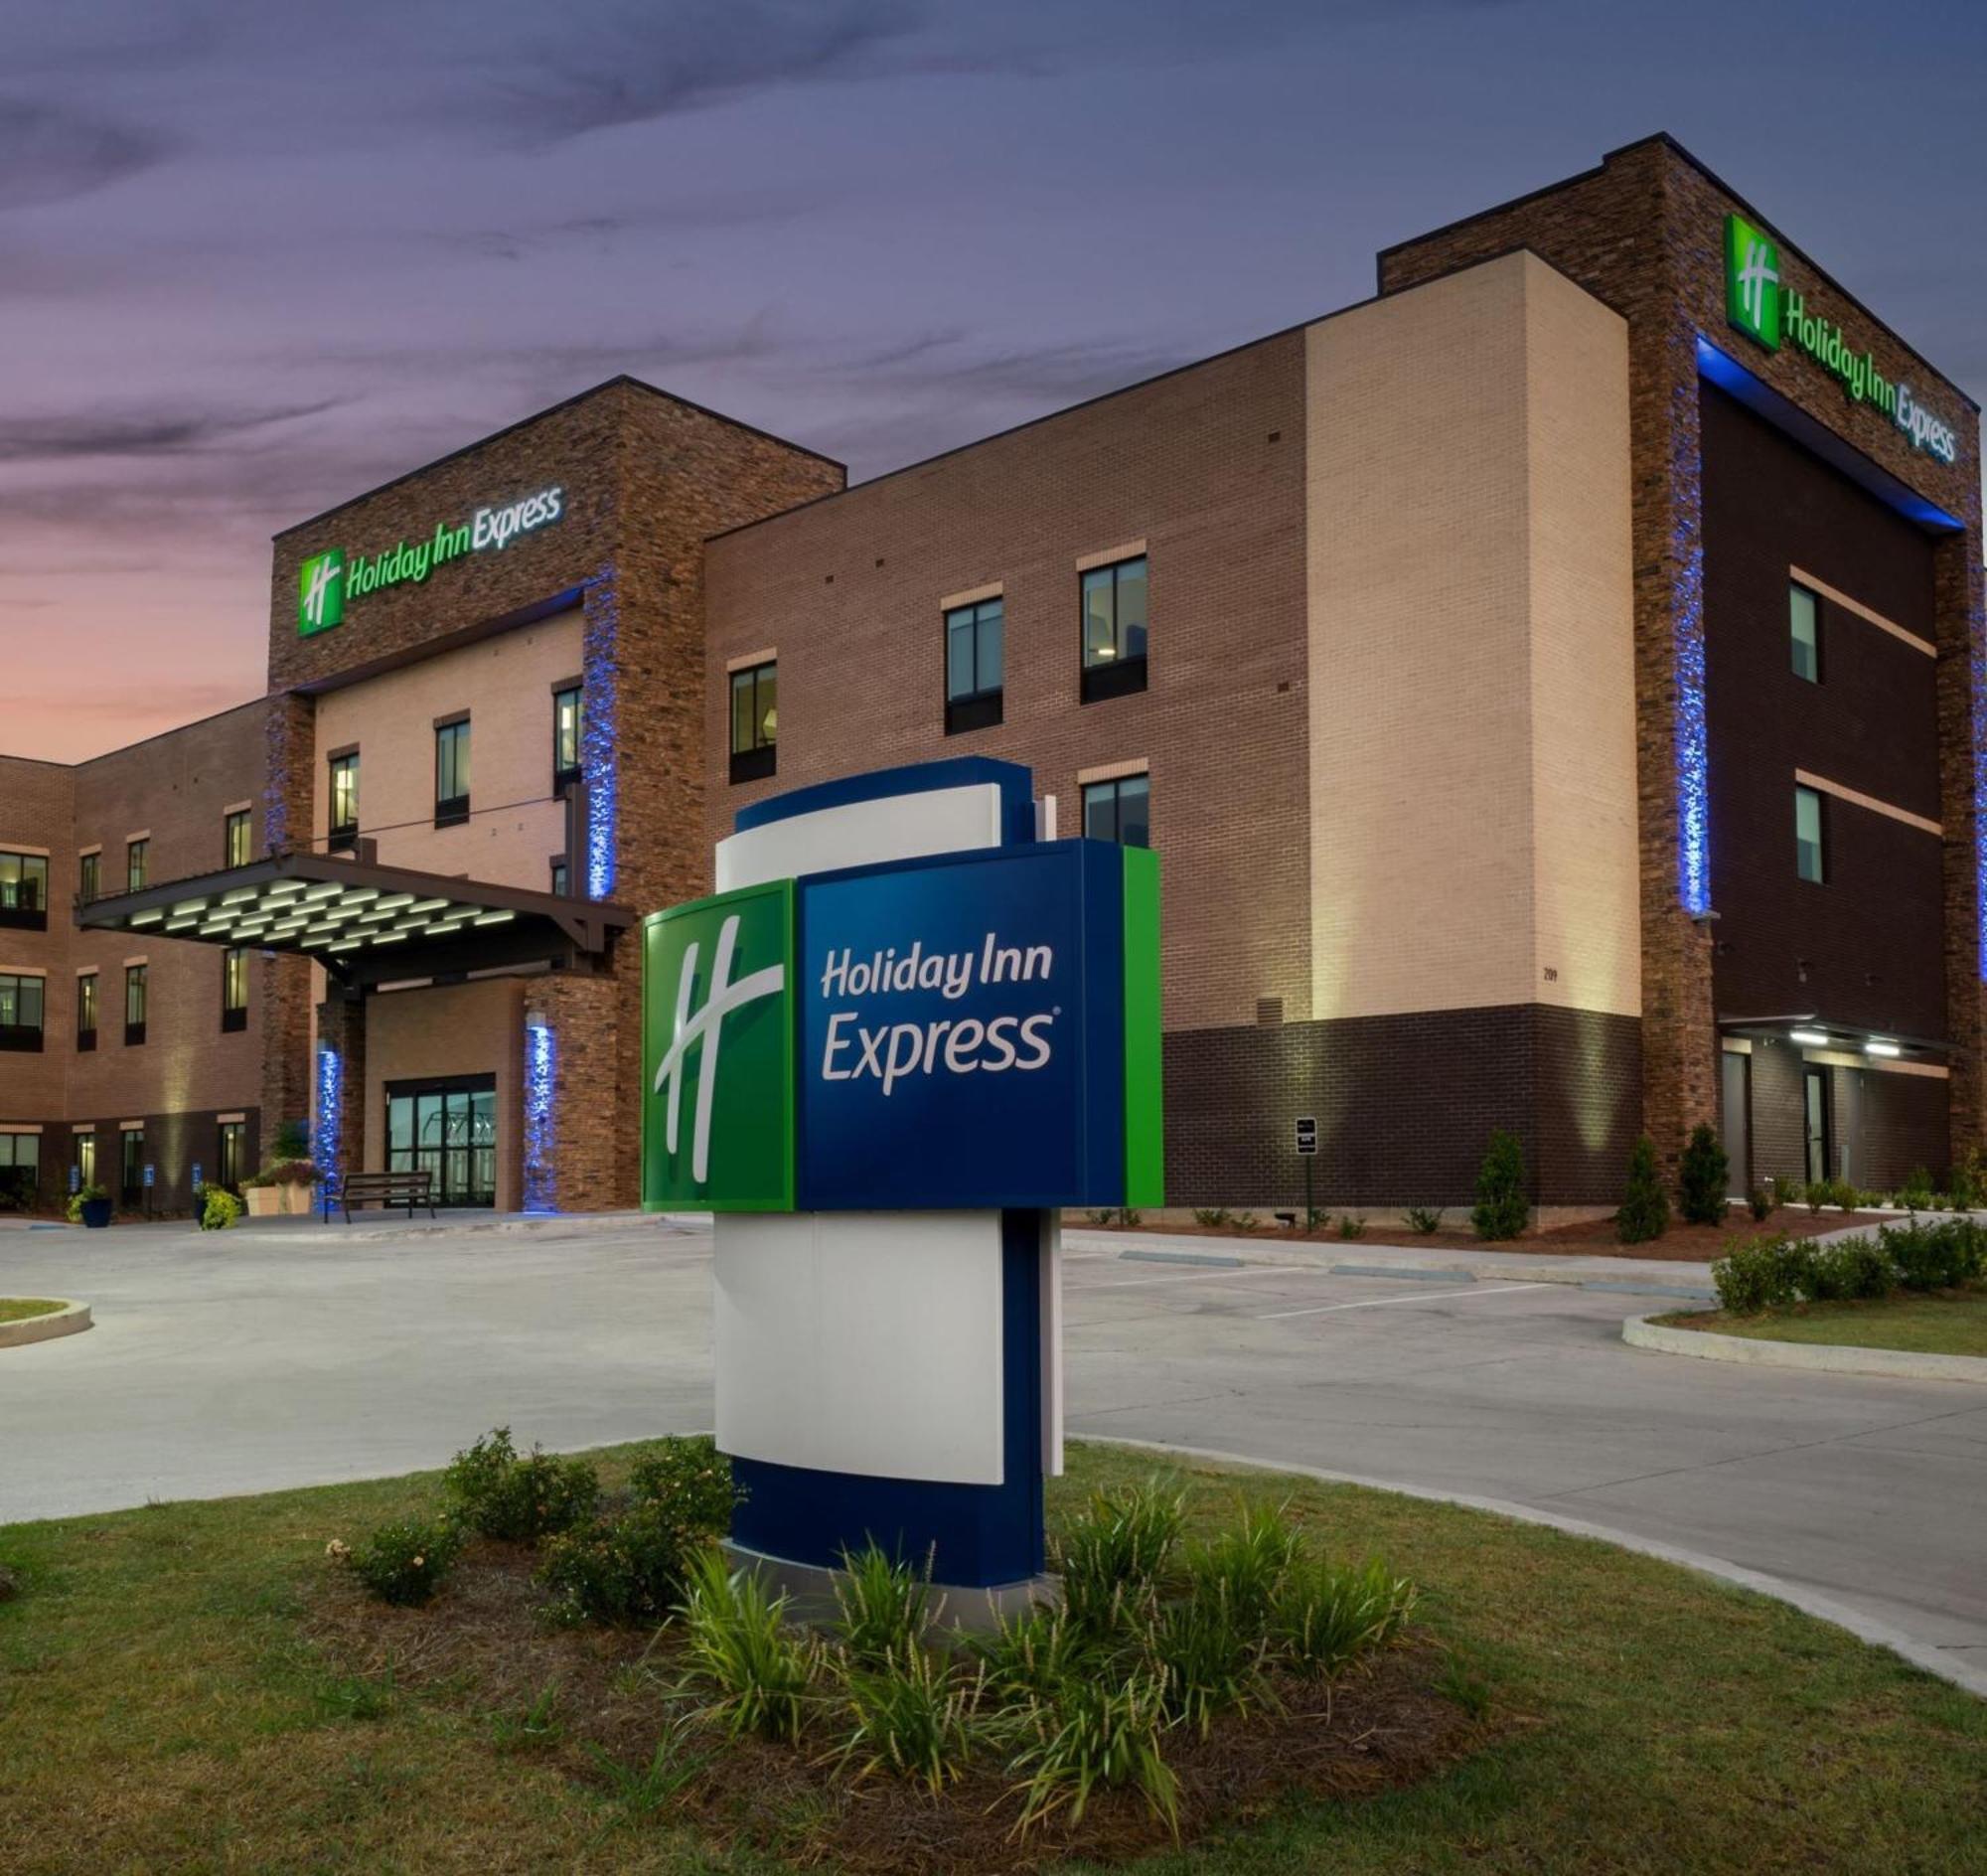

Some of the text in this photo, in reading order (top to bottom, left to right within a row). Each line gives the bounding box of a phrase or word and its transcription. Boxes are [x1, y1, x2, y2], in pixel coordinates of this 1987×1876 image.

[1786, 287, 1955, 462] Holiday Inn Express
[346, 487, 561, 599] Holiday Inn Express
[821, 932, 1053, 1000] Holiday Inn
[822, 1011, 1055, 1096] Express
